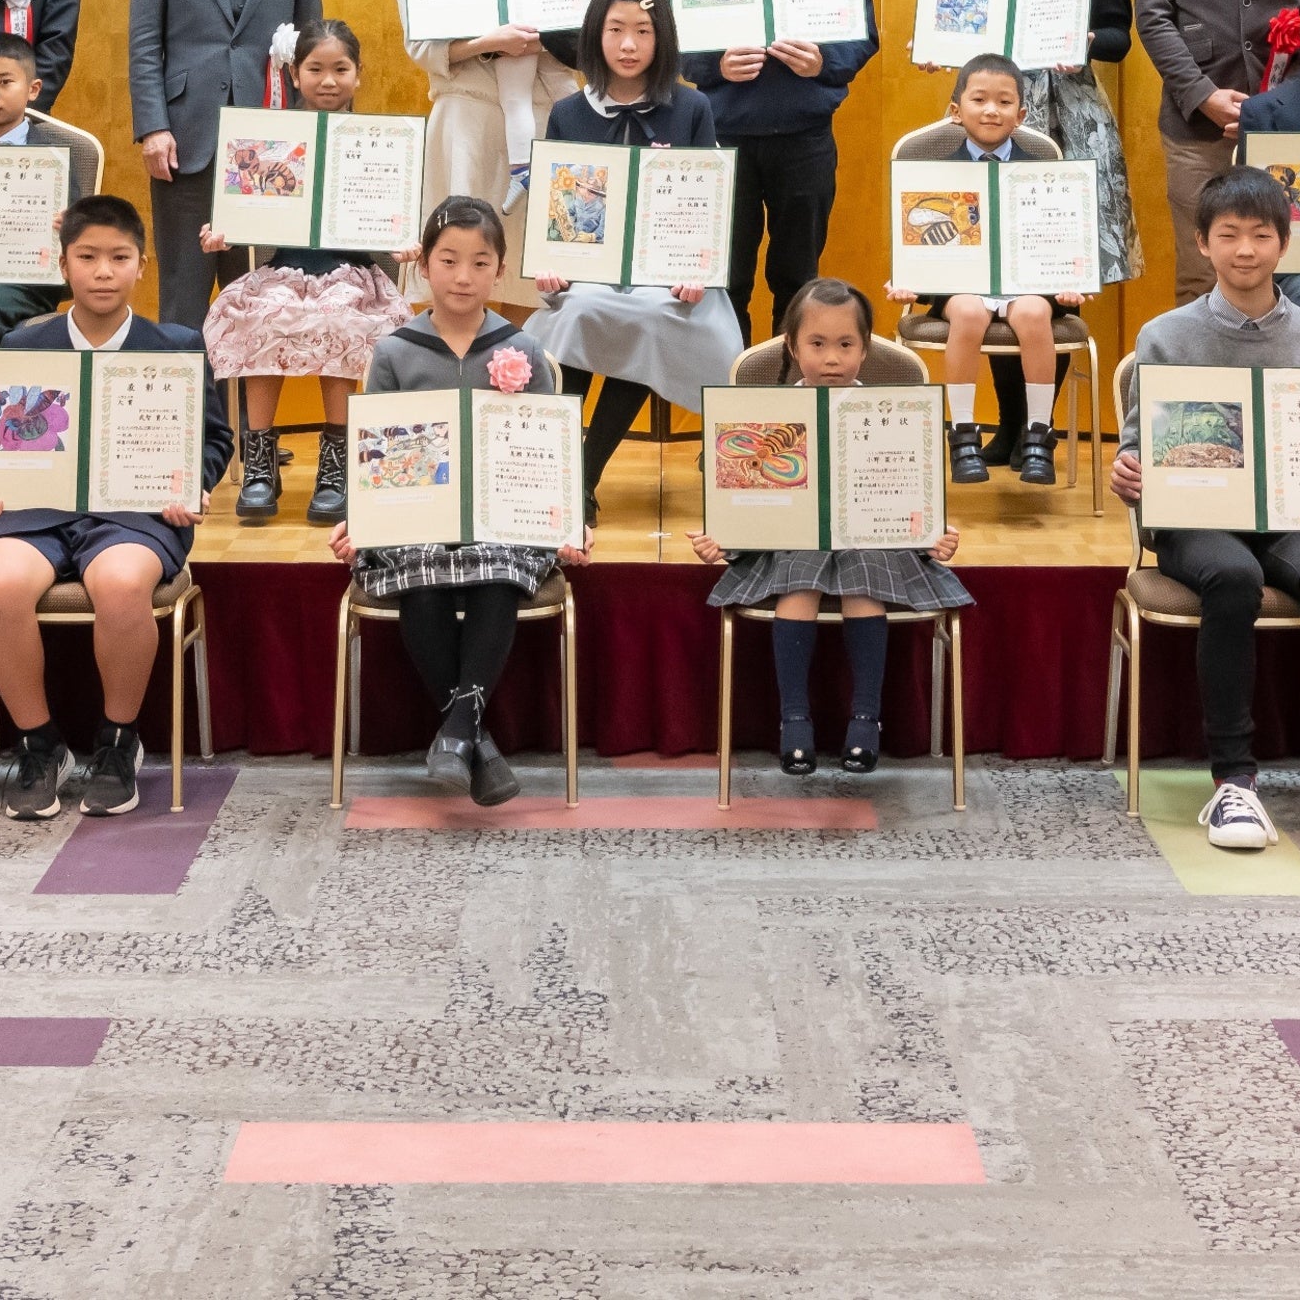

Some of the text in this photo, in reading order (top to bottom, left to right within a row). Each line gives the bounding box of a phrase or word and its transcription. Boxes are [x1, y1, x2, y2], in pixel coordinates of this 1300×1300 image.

[127, 383, 172, 392] 表彰状
[862, 417, 909, 427] 表彰状
